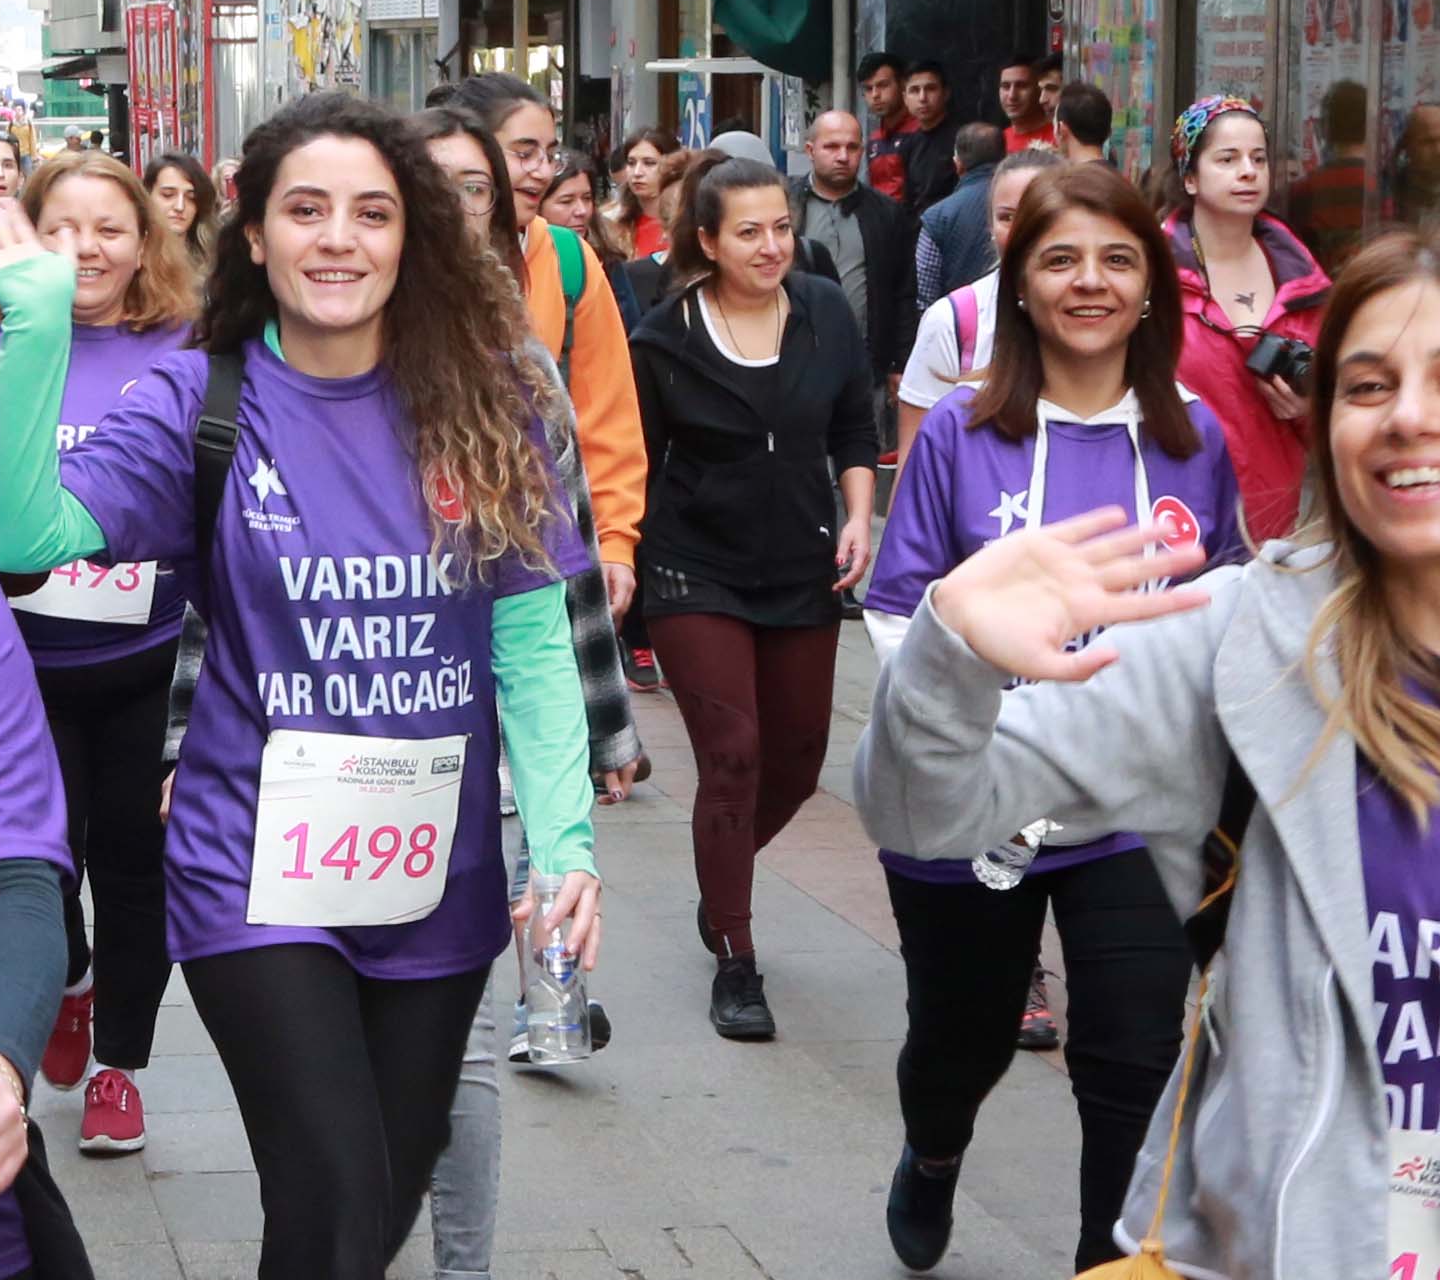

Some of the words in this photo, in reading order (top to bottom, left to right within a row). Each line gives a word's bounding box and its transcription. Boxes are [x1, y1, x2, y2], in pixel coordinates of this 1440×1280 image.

[278, 552, 456, 602] VARDIK
[298, 612, 436, 662] VARIZ
[325, 656, 474, 718] OLACAĞIZ
[280, 821, 437, 882] 1498
